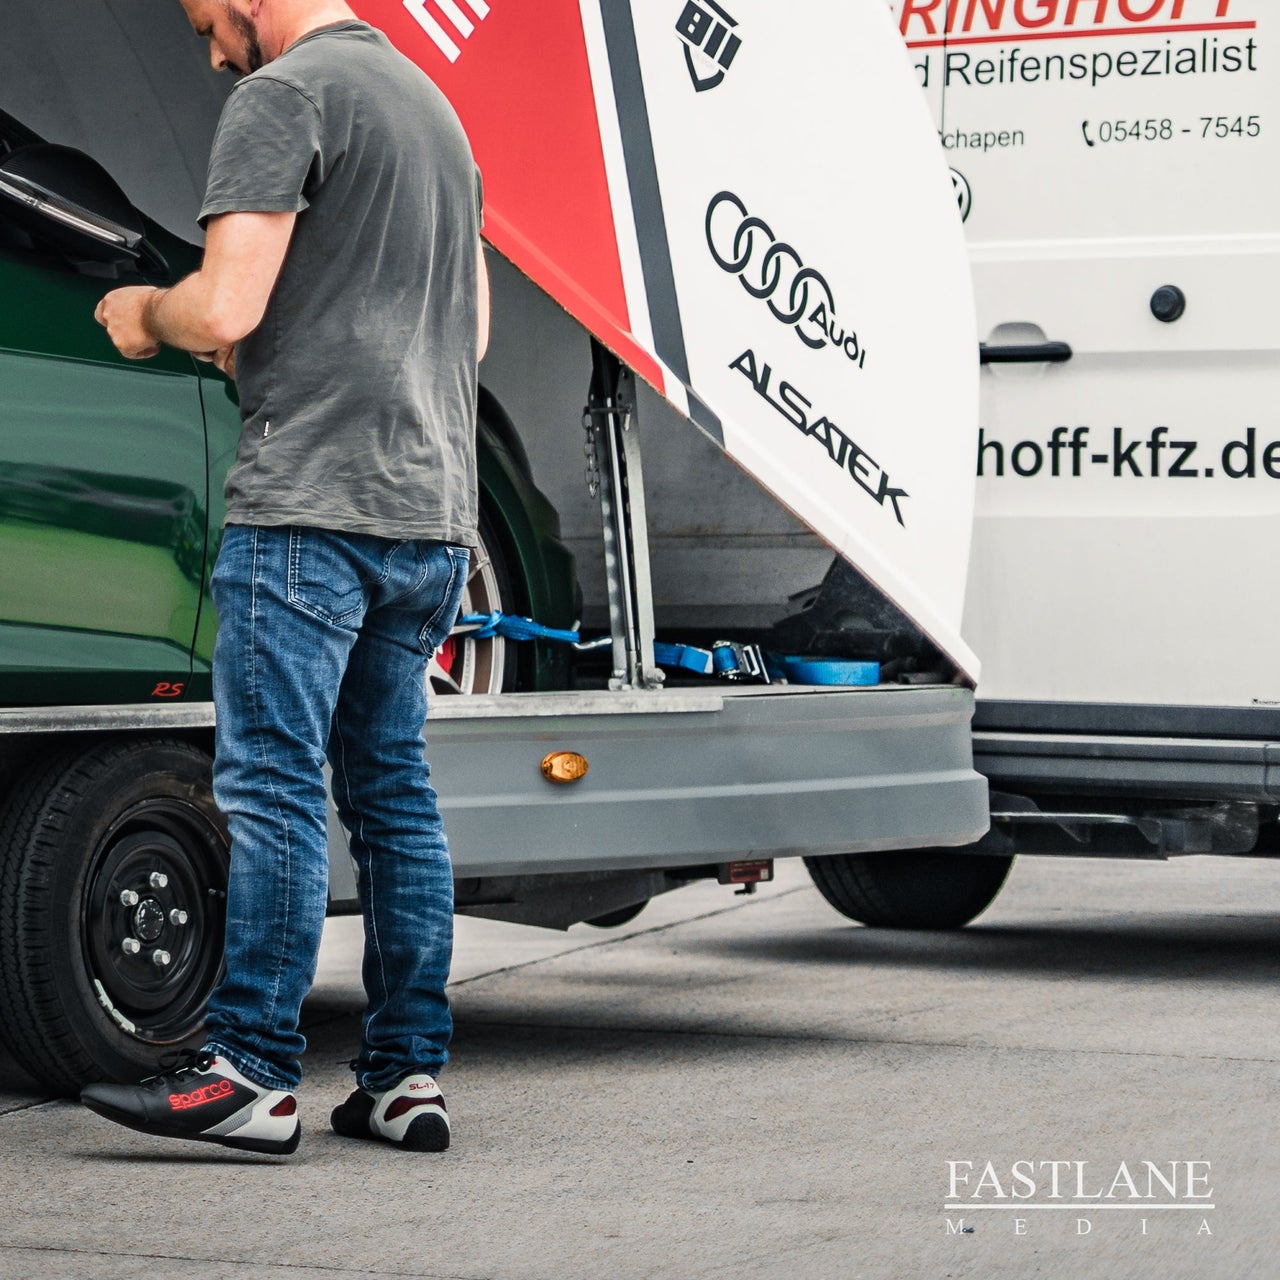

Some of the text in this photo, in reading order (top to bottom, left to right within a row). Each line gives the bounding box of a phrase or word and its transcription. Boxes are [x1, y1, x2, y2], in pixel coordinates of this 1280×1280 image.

[943, 37, 1258, 87] Reifenspezialist
[938, 128, 1025, 153] chapen
[1098, 118, 1173, 143] 05458
[1199, 115, 1261, 139] 7545
[727, 348, 911, 529] ALSATEK
[151, 681, 185, 697] RS
[168, 1079, 233, 1110] sparco
